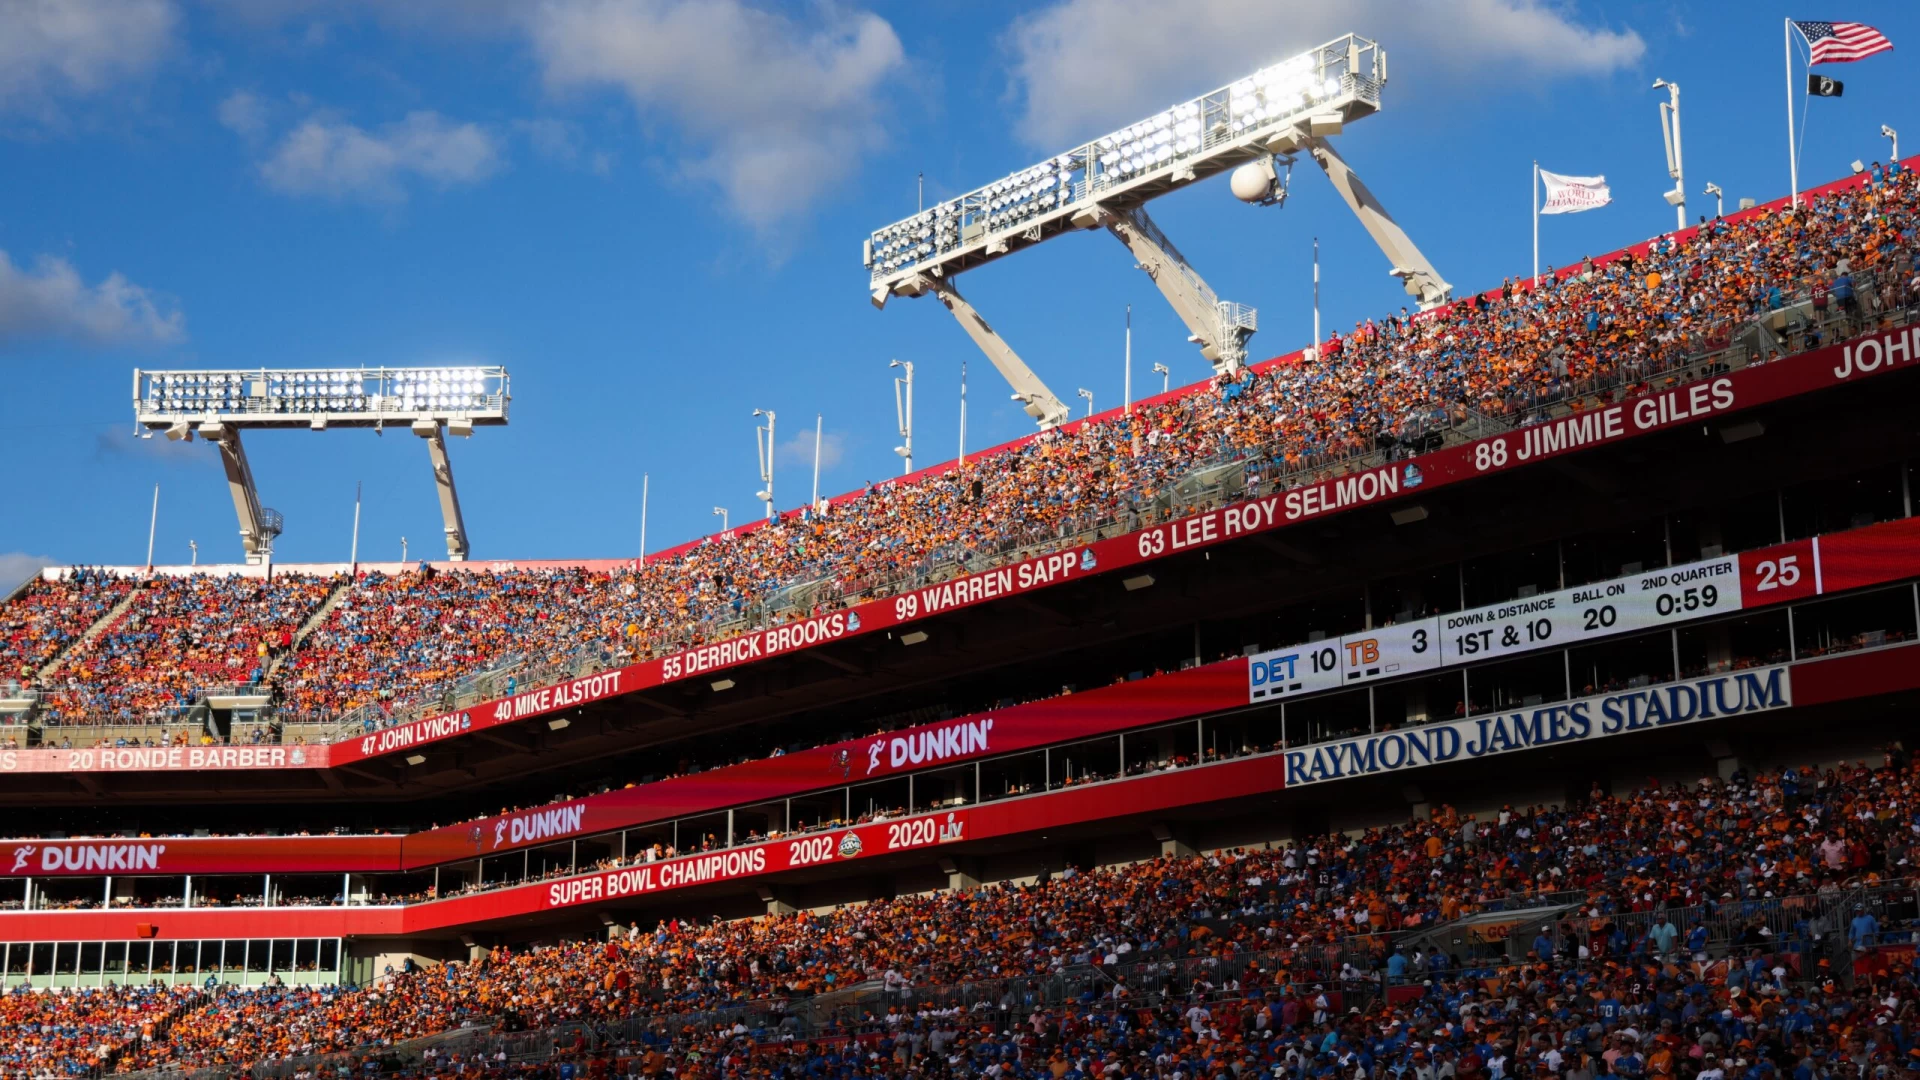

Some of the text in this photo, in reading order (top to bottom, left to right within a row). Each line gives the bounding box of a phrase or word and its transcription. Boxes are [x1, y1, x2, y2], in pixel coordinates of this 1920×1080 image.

[1557, 188, 1596, 200] WORLD
[1475, 378, 1735, 471] 88 JIMMIE GILES
[1138, 467, 1399, 557] 63 LEE ROY SELMON
[895, 551, 1077, 620] 99 WARREN SAPP
[1641, 562, 1733, 591] 2ND QUARTER
[1755, 555, 1801, 592] 25
[1448, 597, 1556, 630] DOWN & DISTANCE
[1572, 583, 1626, 605] BALL ON
[1655, 584, 1718, 617] 0:59
[1456, 617, 1553, 656] 1ST & 10
[1583, 604, 1617, 632] 20
[662, 613, 845, 680] 55 DERRICK BROOKS
[1345, 628, 1428, 667] TB 3
[1251, 647, 1337, 686] DET 10
[494, 671, 622, 721] 40 MIKE ALSTOTT
[361, 713, 460, 755] 47 JOHN LYNCH
[890, 718, 994, 769] DUNKIN'
[1284, 667, 1786, 785] RAYMOND JAMES STADIUM
[69, 747, 286, 769] 20 RONDÉ BARBER
[510, 803, 587, 844] DUNKIN'
[888, 818, 936, 849] 2020
[41, 844, 166, 871] DUNKIN'
[789, 836, 833, 866] 2002
[550, 847, 766, 906] SUPER BOWL CHAMPIONS
